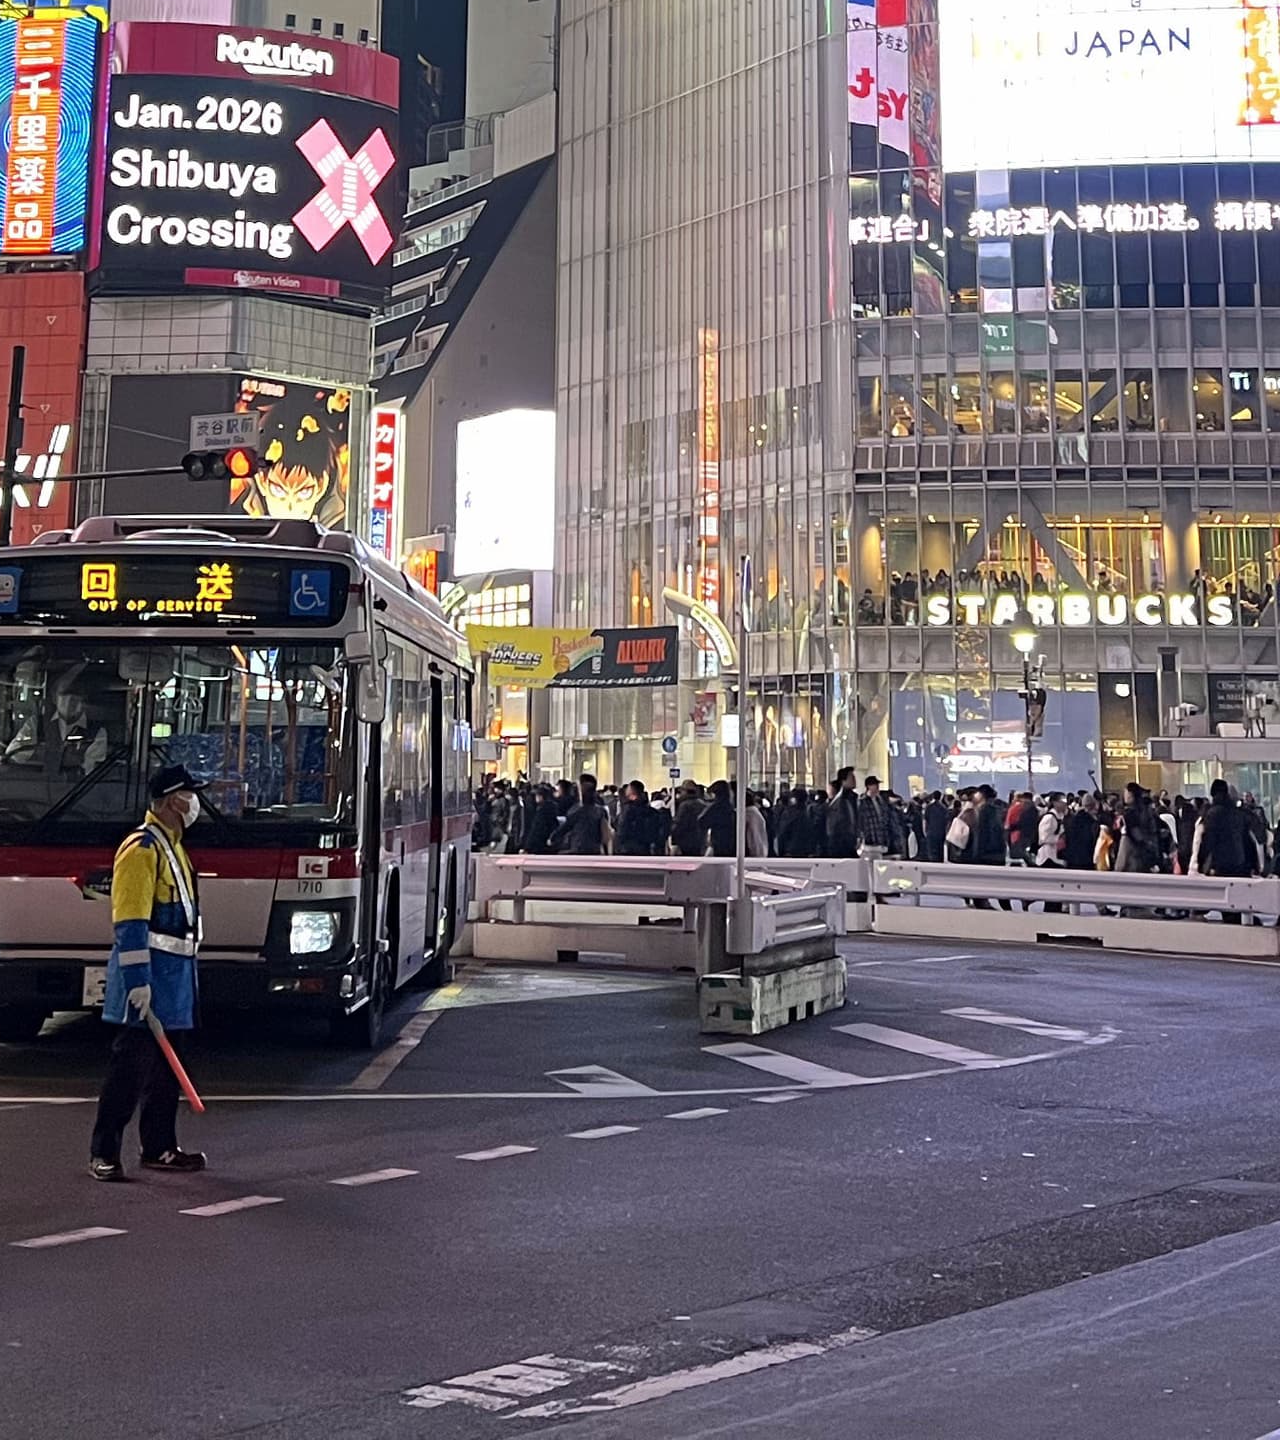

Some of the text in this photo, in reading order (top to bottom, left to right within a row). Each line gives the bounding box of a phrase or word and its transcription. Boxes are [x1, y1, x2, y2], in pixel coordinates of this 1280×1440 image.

[216, 33, 335, 76] Rakuten
[1065, 26, 1190, 58] JAPAN
[7, 26, 58, 242] 三千里薬品
[110, 147, 277, 198] Shibuya
[106, 204, 295, 259] Crossing
[273, 276, 300, 288] Vision
[196, 416, 254, 437] 渋谷駅前
[81, 561, 235, 601] 回 送
[88, 600, 224, 612] OUT OF SERVICE
[926, 593, 1234, 627] STARBUCKS
[297, 880, 323, 894] 1710
